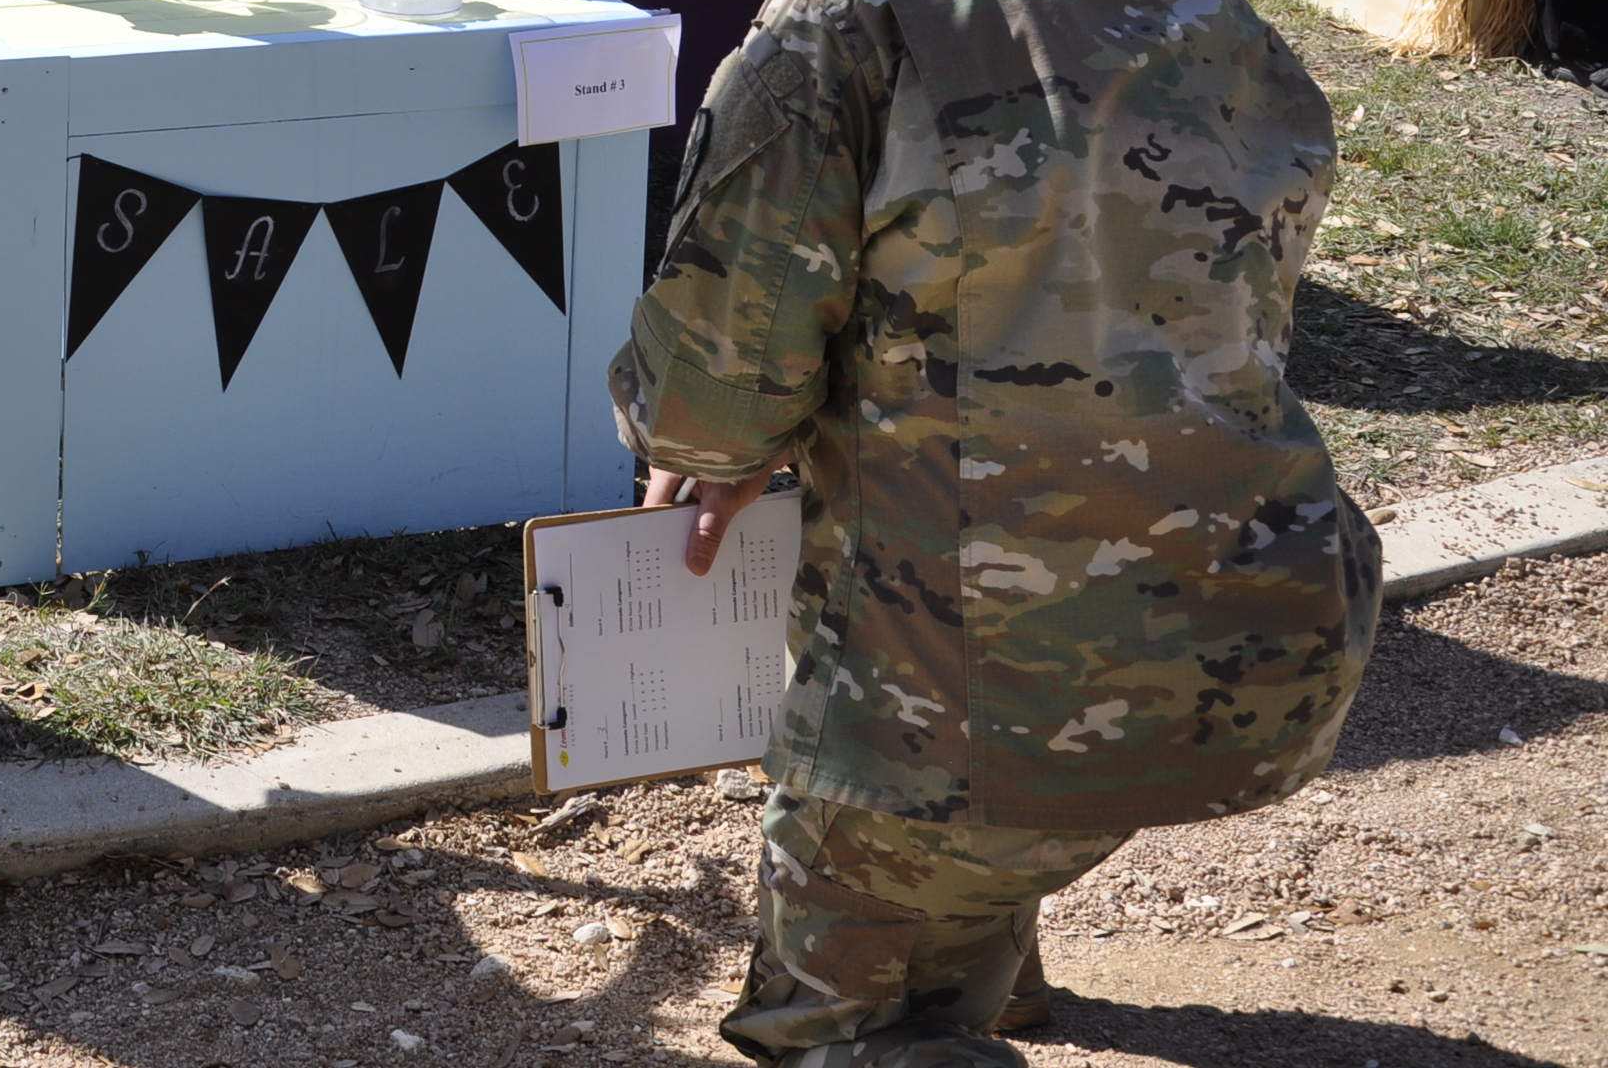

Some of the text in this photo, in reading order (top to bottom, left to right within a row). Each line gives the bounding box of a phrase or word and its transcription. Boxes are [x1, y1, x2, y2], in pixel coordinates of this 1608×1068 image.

[574, 79, 625, 97] Stand # 3
